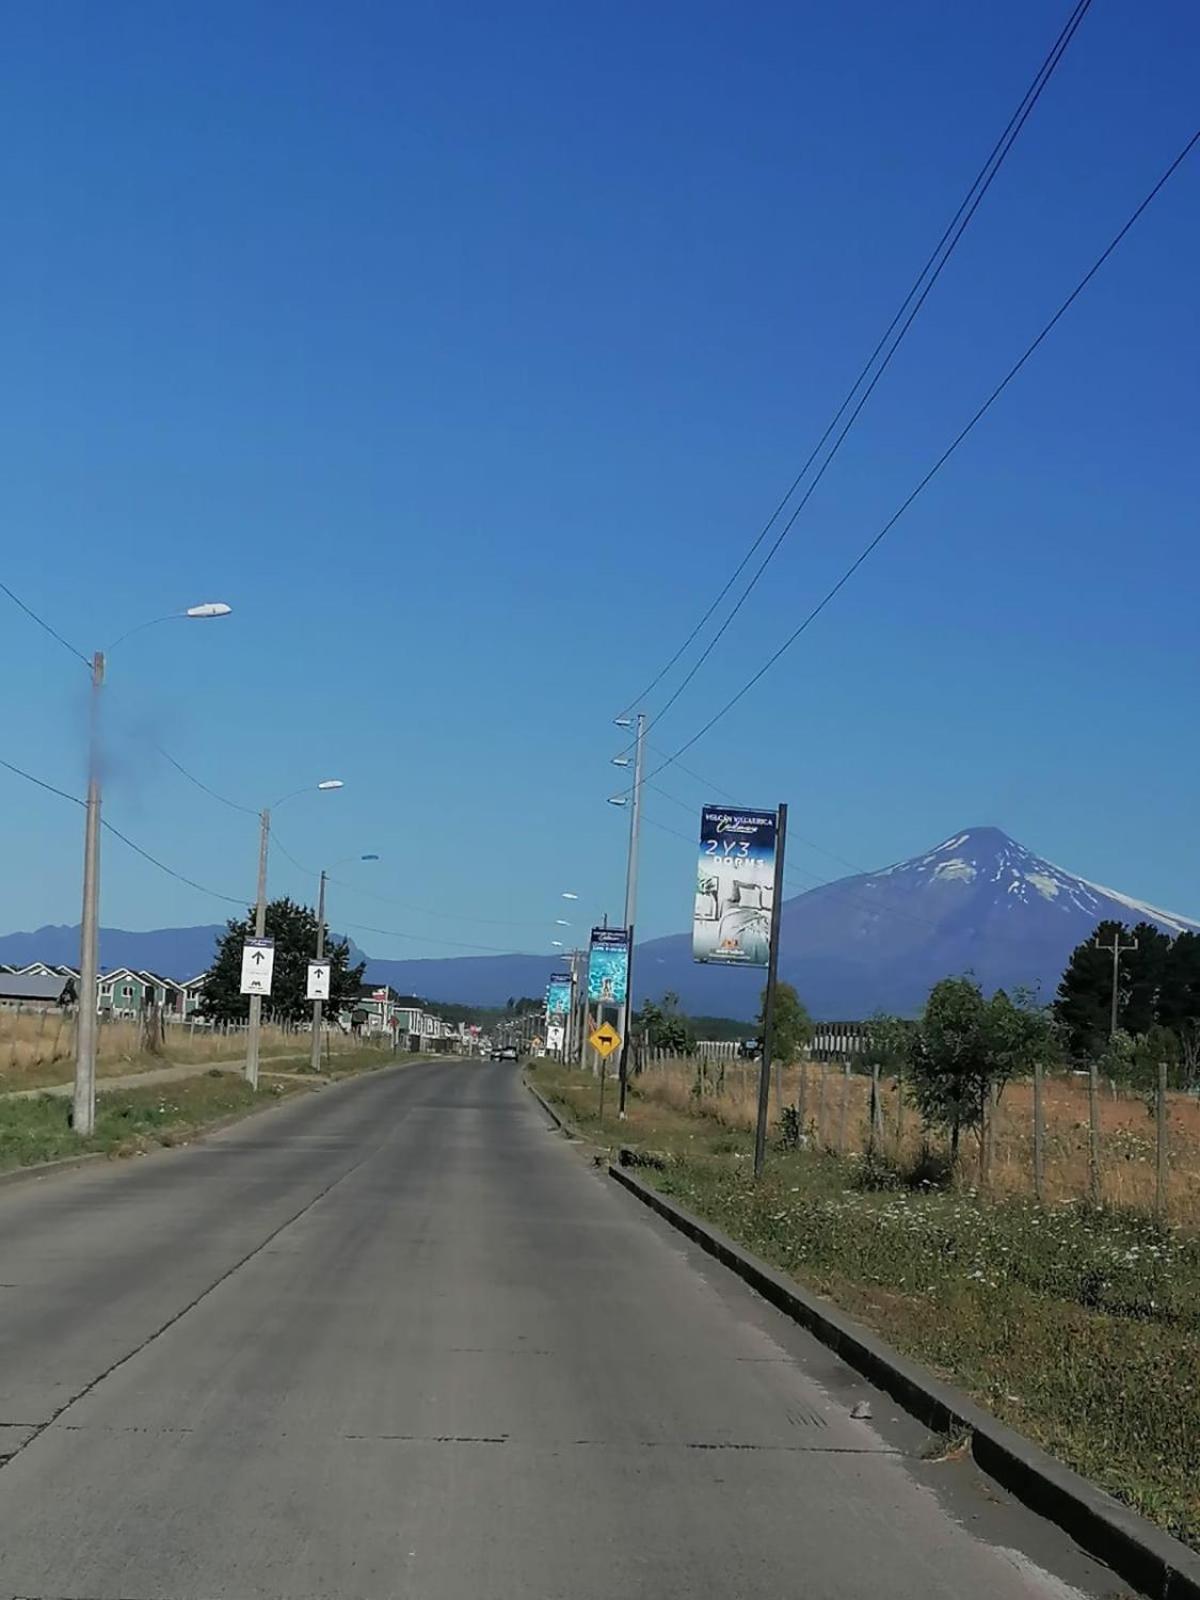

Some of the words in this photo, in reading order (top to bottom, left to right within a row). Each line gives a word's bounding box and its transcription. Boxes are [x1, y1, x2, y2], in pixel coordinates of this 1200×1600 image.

[705, 839, 719, 855] 2
[723, 840, 736, 857] Y
[737, 841, 751, 858] 3
